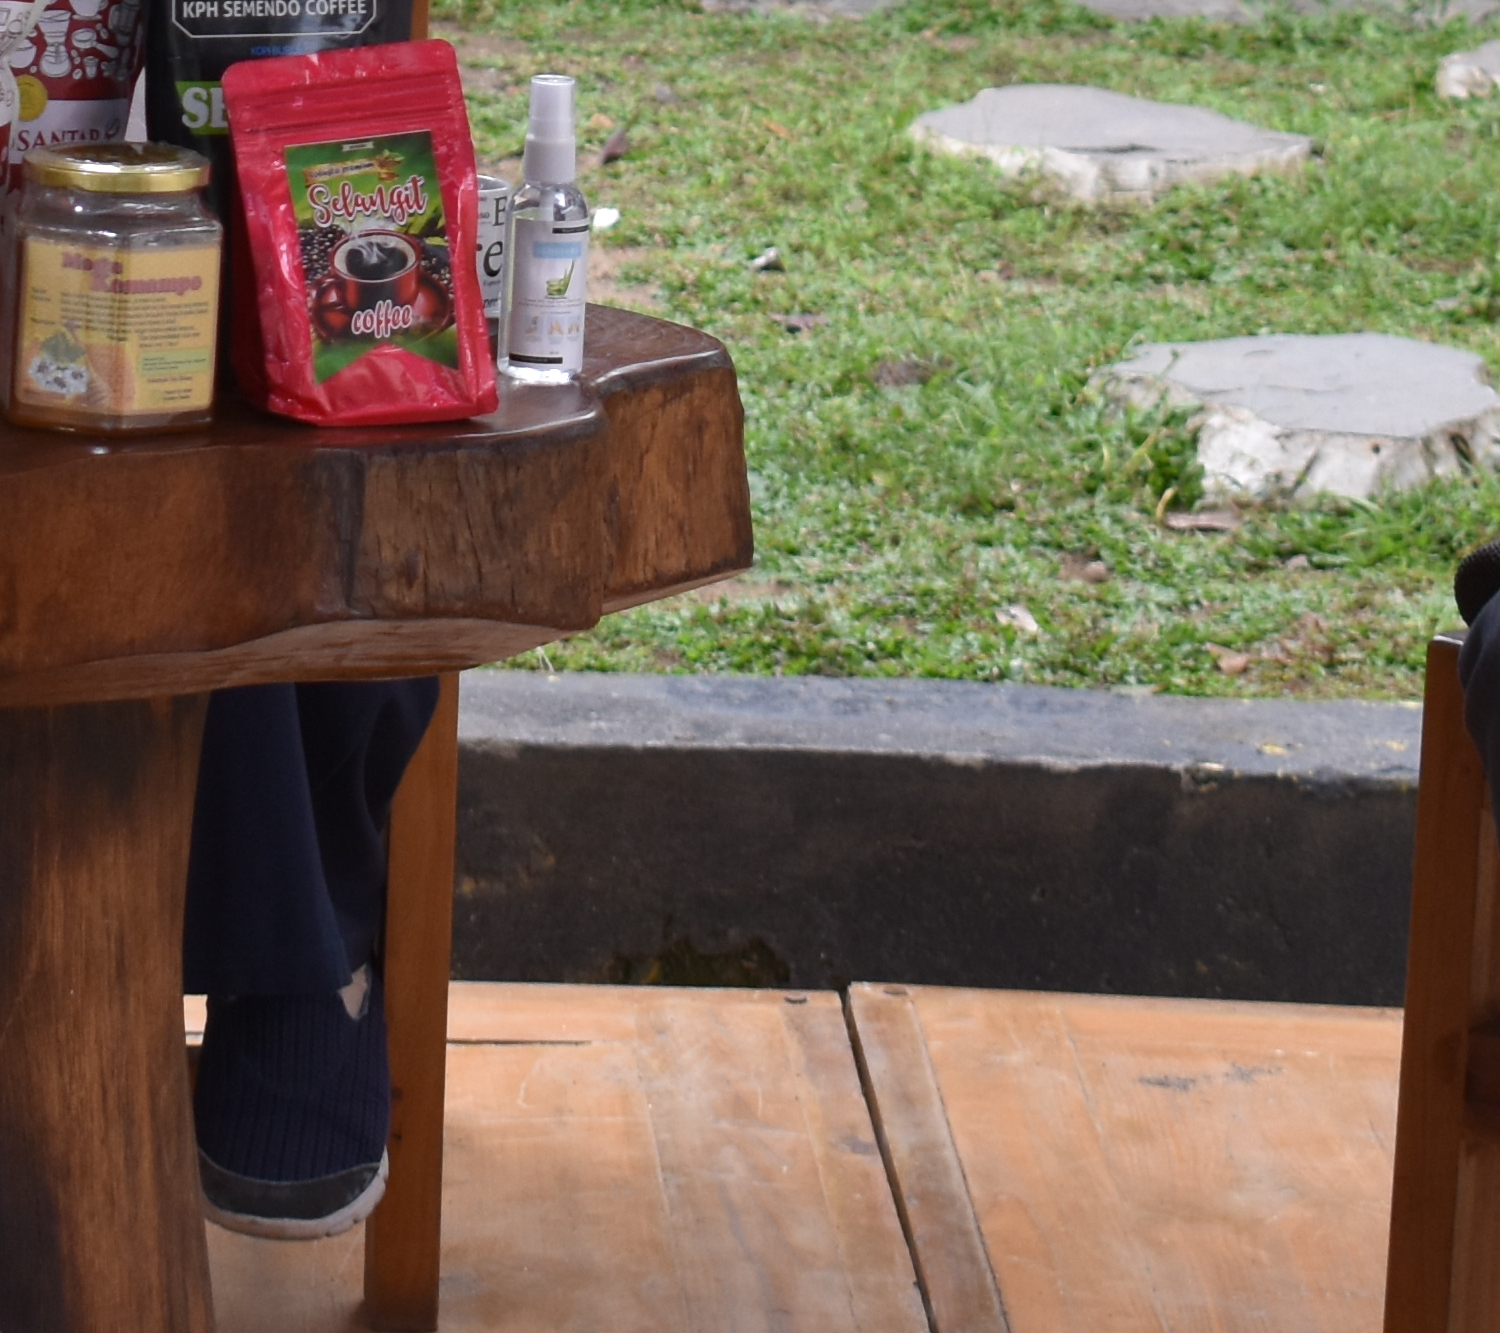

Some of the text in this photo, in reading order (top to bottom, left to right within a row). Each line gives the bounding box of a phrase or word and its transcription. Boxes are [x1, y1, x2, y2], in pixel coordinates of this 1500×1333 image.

[182, 0, 219, 19] KPH
[307, 174, 428, 229] Selangit
[351, 299, 414, 339] coffee
